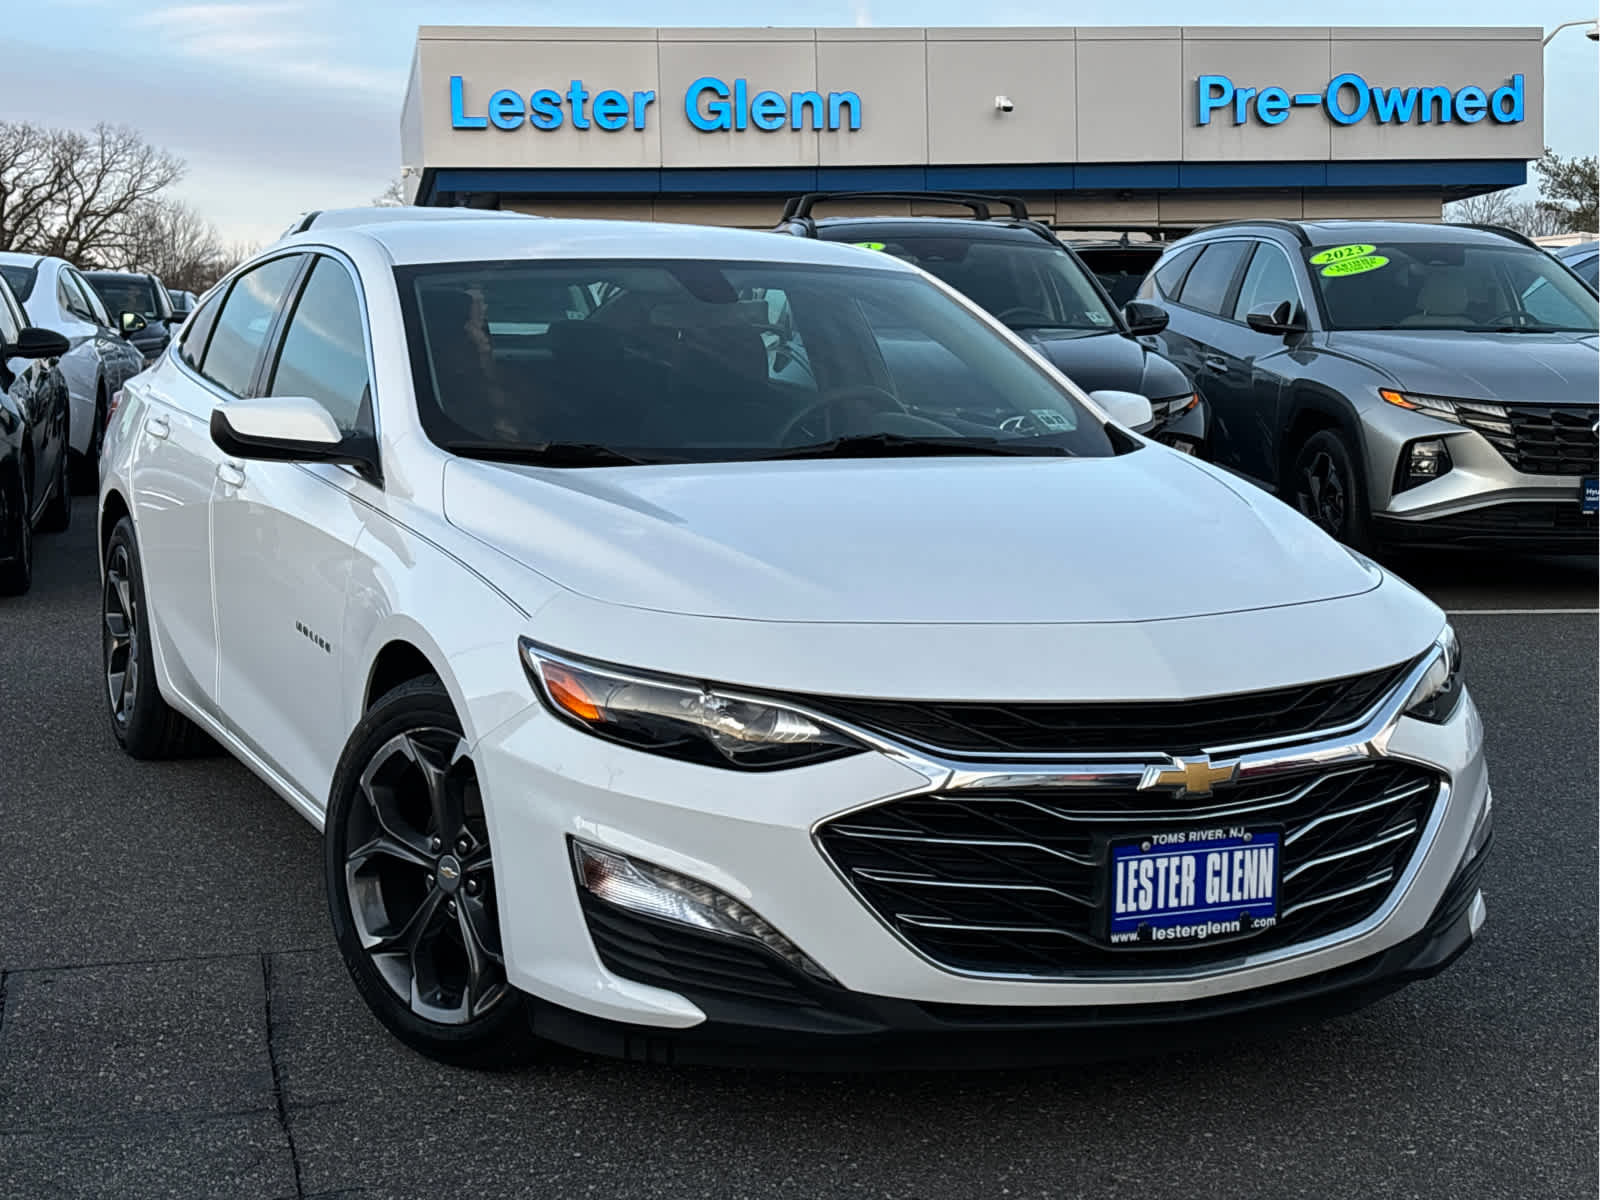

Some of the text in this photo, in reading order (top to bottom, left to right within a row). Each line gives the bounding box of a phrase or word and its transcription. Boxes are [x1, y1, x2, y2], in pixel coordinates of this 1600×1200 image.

[450, 75, 862, 131] Lester Glenn
[1197, 73, 1525, 125] Pre-Owned
[1325, 245, 1364, 263] 2023
[1152, 827, 1245, 846] TOMS RIVER, NJ
[1115, 847, 1274, 914] LESTER GLENN
[1110, 916, 1276, 944] www. lesterglenn .com
